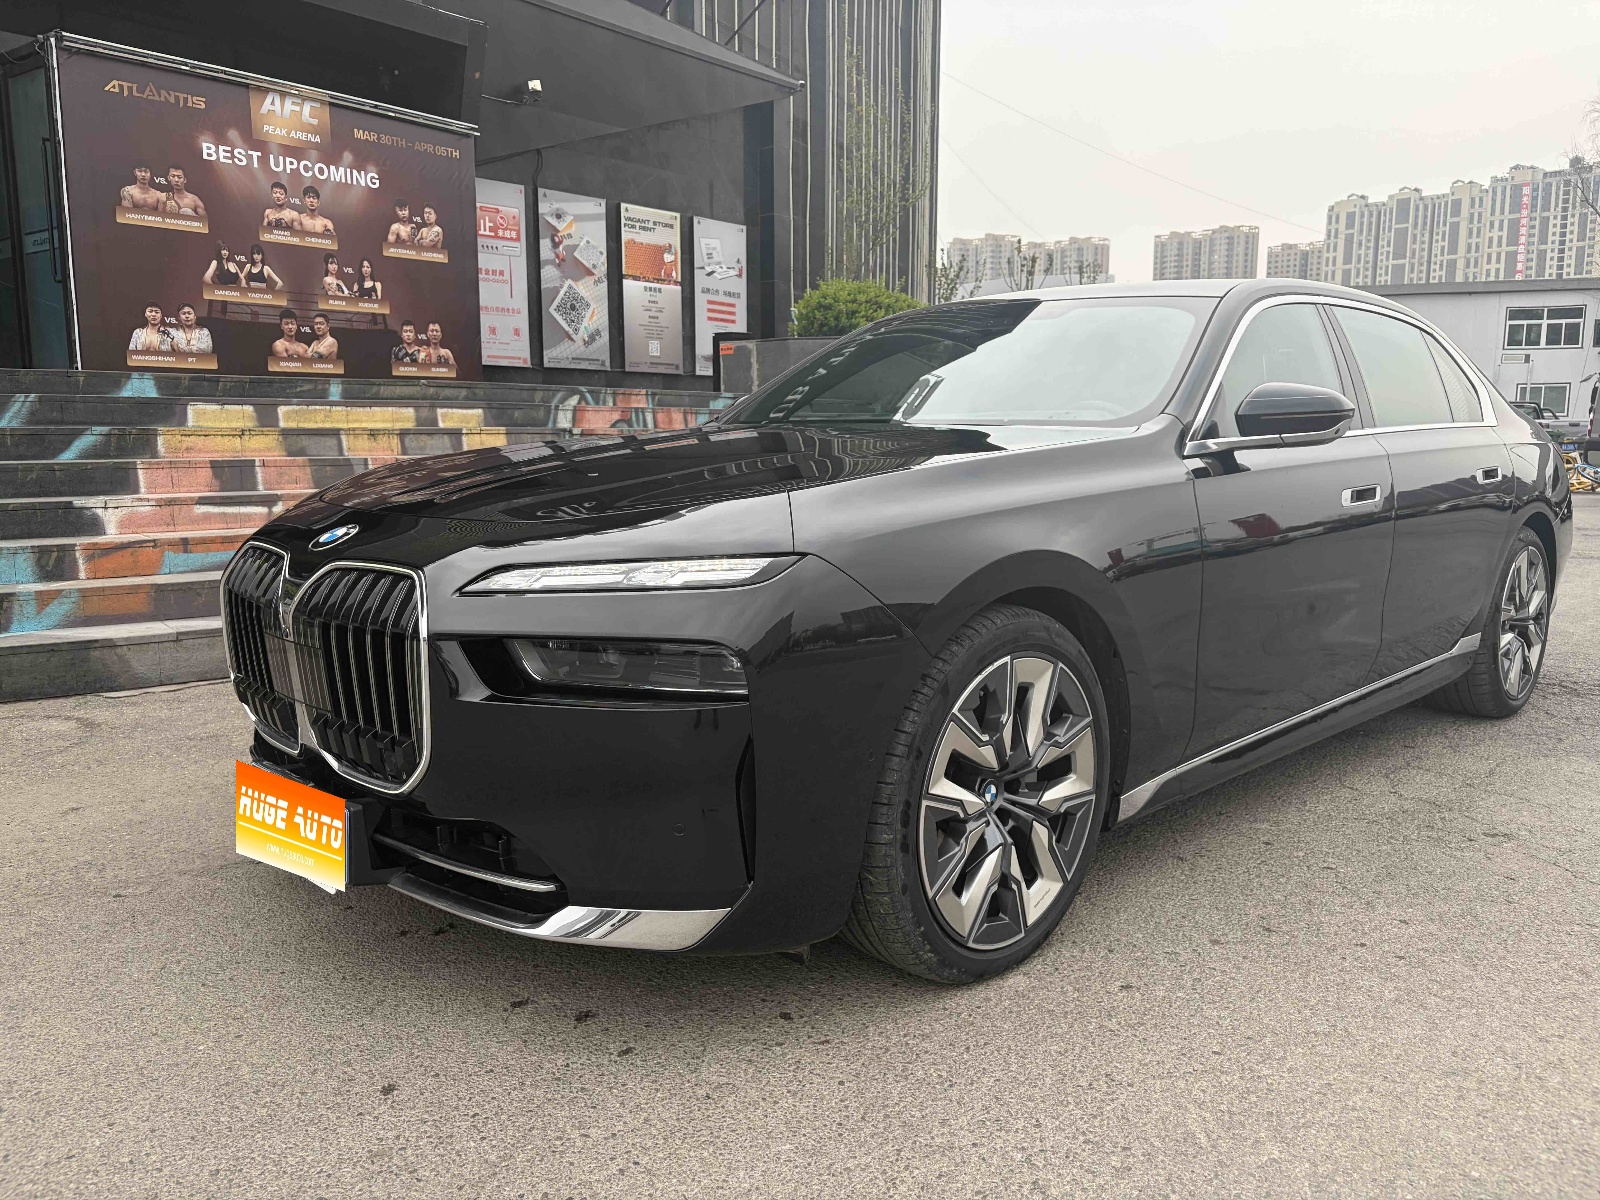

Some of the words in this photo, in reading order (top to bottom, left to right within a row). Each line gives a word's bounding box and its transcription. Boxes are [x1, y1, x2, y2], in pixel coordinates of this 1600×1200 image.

[104, 80, 206, 109] ATLANTIS
[260, 91, 320, 125] AFC
[263, 125, 288, 137] PEAK
[289, 130, 321, 143] ARENA
[353, 128, 378, 142] MAR
[379, 134, 406, 148] 30TH
[414, 141, 434, 154] APR
[435, 146, 460, 159] 05TH
[202, 141, 262, 168] BEST
[269, 154, 380, 189] UPCOMING
[623, 215, 652, 225] VACANT
[652, 220, 675, 230] STORE
[623, 222, 637, 230] FOR
[638, 225, 657, 233] RENT
[214, 289, 240, 297] DANDAN
